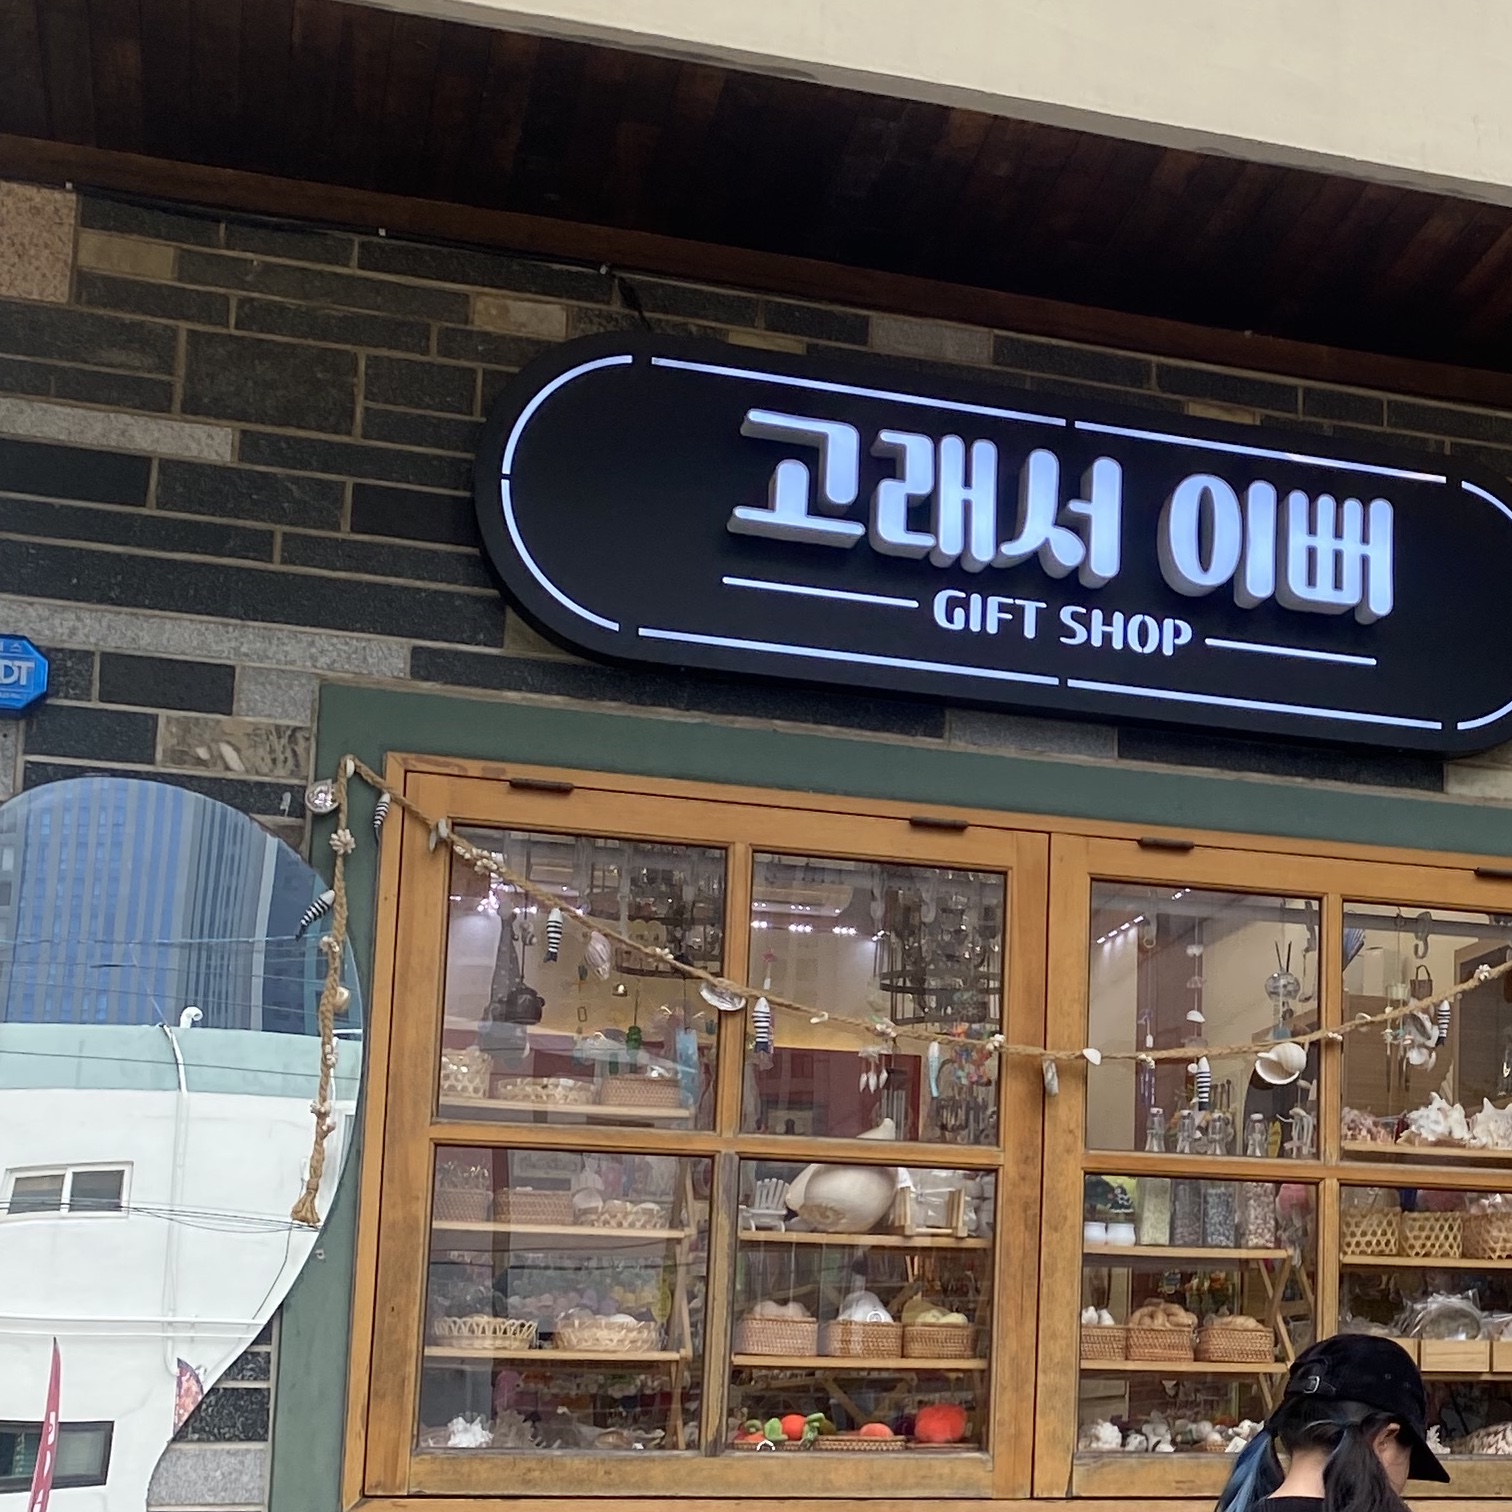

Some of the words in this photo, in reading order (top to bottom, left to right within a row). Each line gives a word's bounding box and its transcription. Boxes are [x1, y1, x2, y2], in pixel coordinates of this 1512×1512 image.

[727, 407, 1123, 588] 고래서
[1156, 470, 1396, 625] 이뻐
[933, 589, 1047, 640] GIFT
[1059, 606, 1194, 656] SHOP
